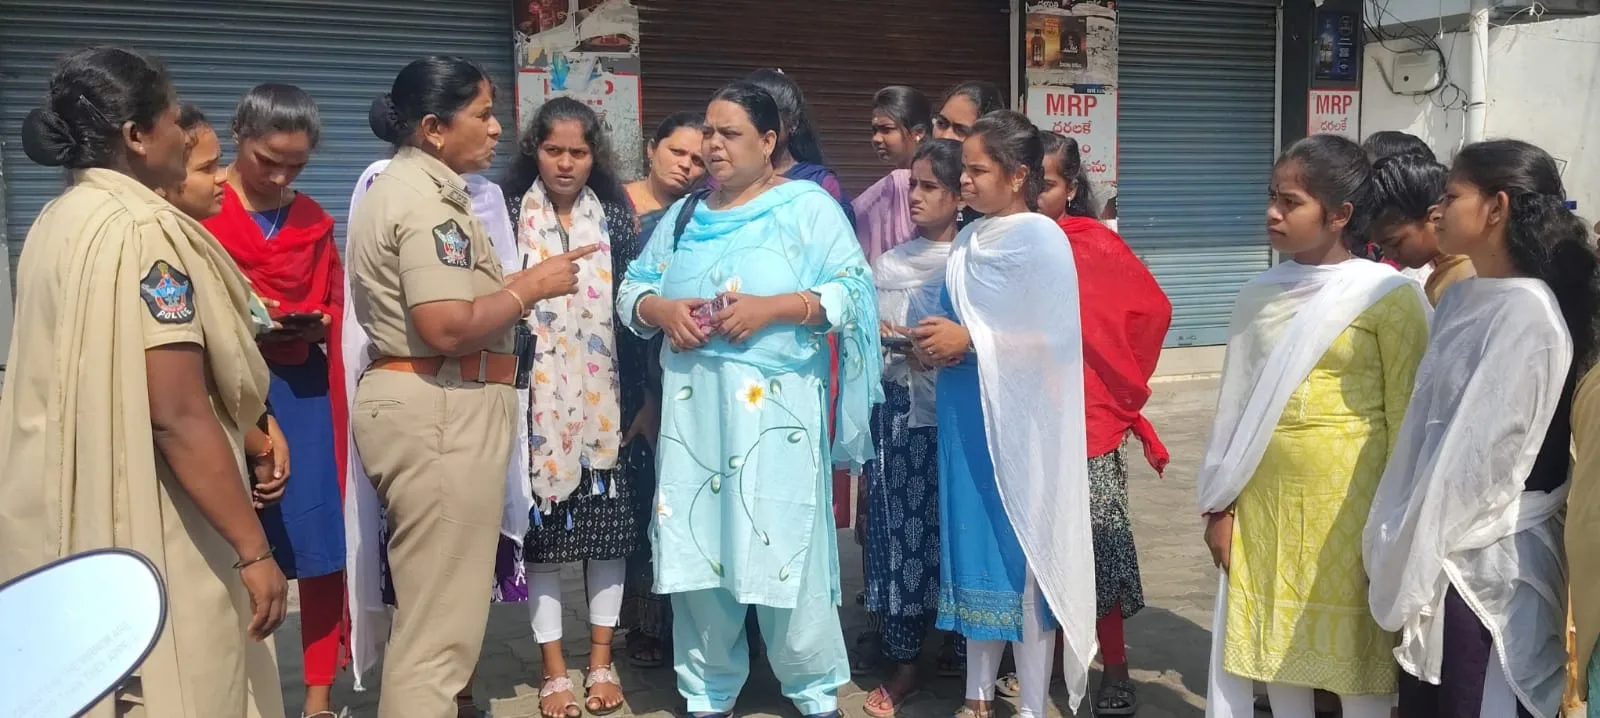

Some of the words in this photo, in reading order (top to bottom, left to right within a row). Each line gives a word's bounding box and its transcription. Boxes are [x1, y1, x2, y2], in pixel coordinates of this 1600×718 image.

[1046, 93, 1098, 117] MRP
[1316, 95, 1352, 115] MRP
[156, 307, 192, 319] POLICE
